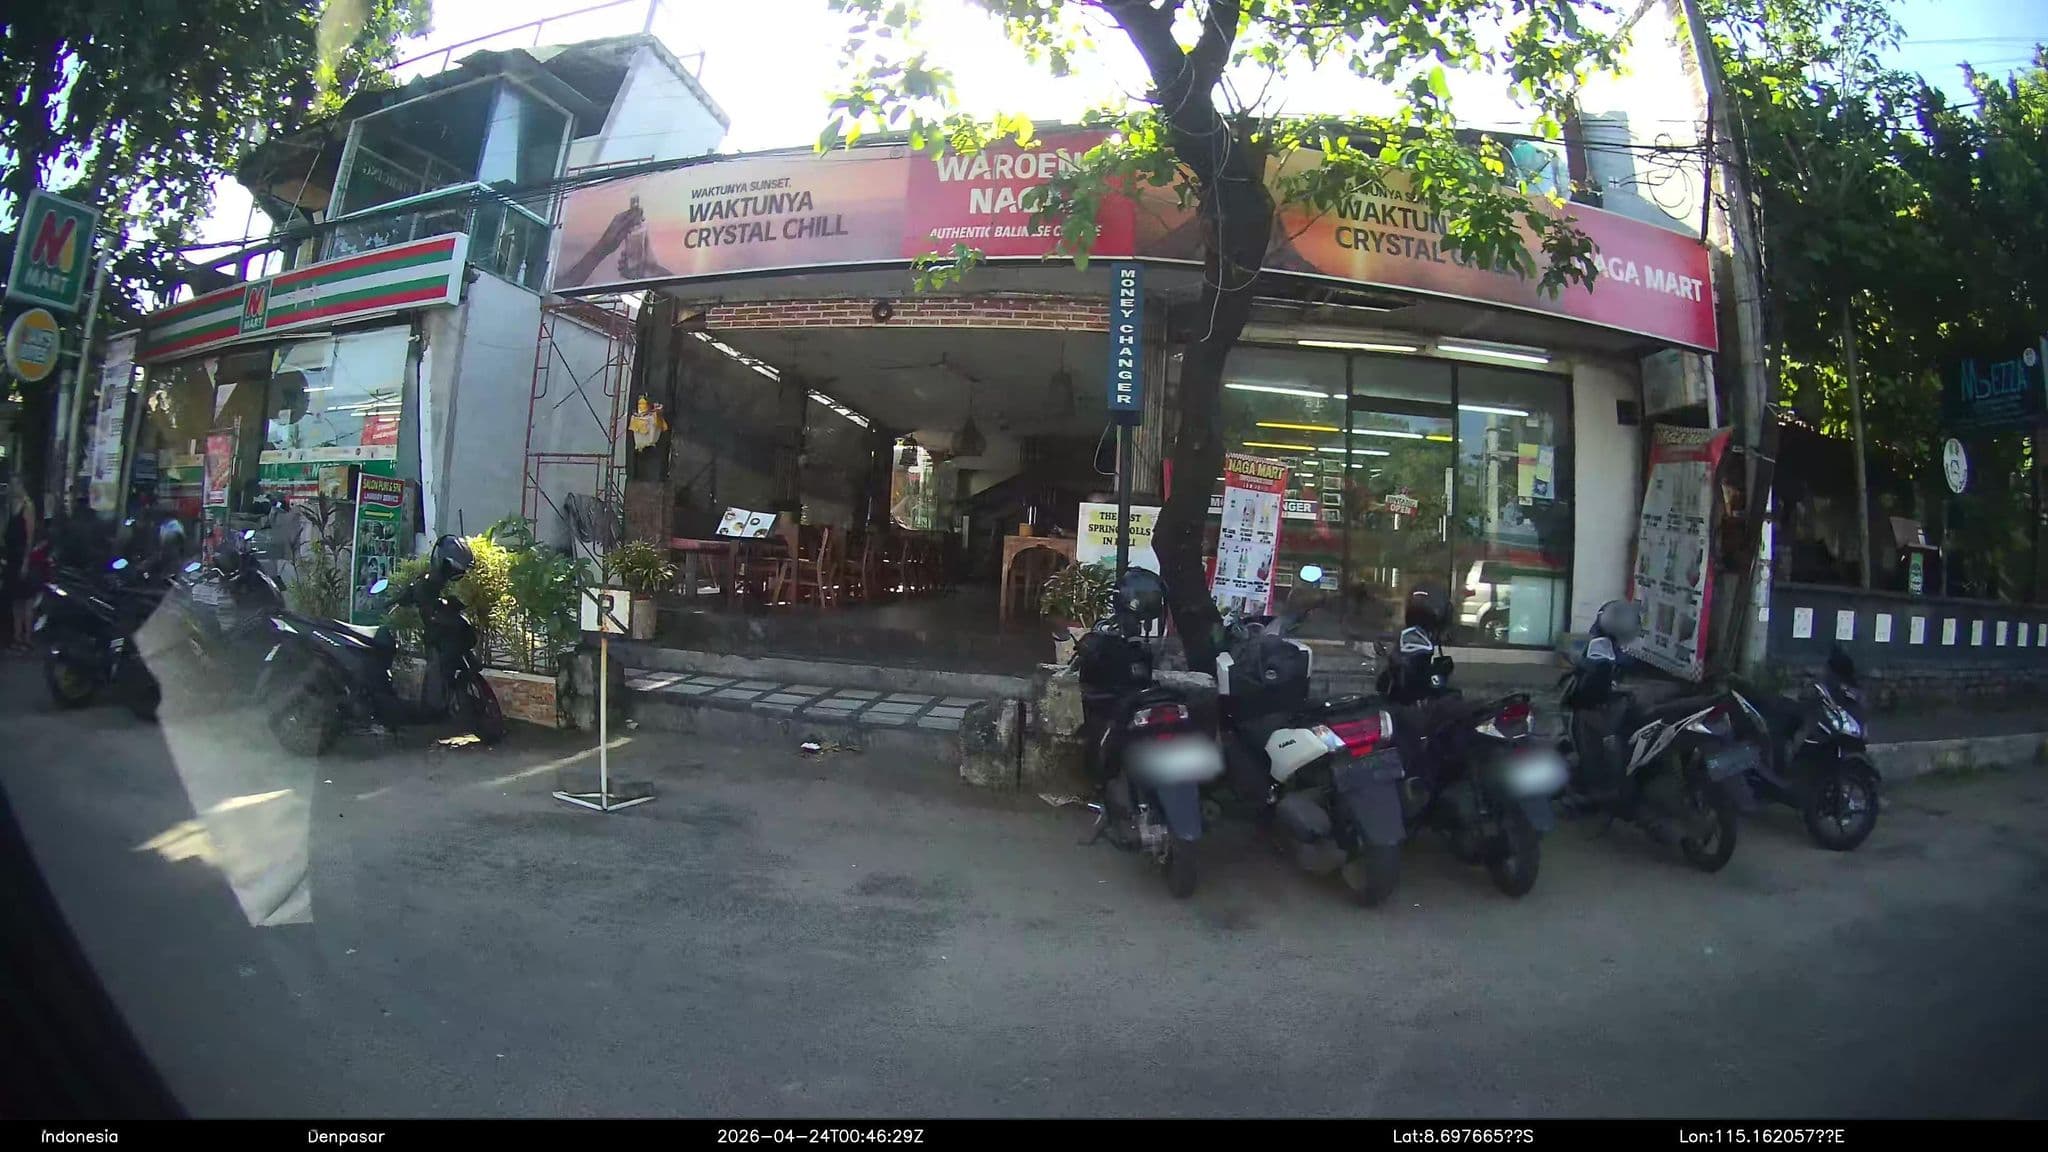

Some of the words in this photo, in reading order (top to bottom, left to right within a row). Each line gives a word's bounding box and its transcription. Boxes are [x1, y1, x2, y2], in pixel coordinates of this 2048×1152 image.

[936, 151, 1098, 182] WAROEN
[691, 182, 748, 200] WAKTUNYA
[689, 191, 814, 223] WAKTUNYA
[1334, 199, 1450, 235] WAKTUN
[684, 220, 777, 249] CRYSTAL
[782, 213, 849, 240] CHILL
[930, 226, 990, 240] AUTHENTIC
[1335, 226, 1446, 264] CRYSTAL
[24, 267, 70, 295] MART
[1119, 269, 1136, 318] MONEY
[1644, 265, 1703, 303] MART
[1116, 324, 1134, 404] CHANGER
[1228, 458, 1256, 476] NAGA
[1257, 463, 1285, 480] MART
[1099, 511, 1118, 520] THE
[1390, 503, 1412, 514] OPEN
[1103, 536, 1113, 545] IN
[1127, 527, 1152, 536] OLLS
